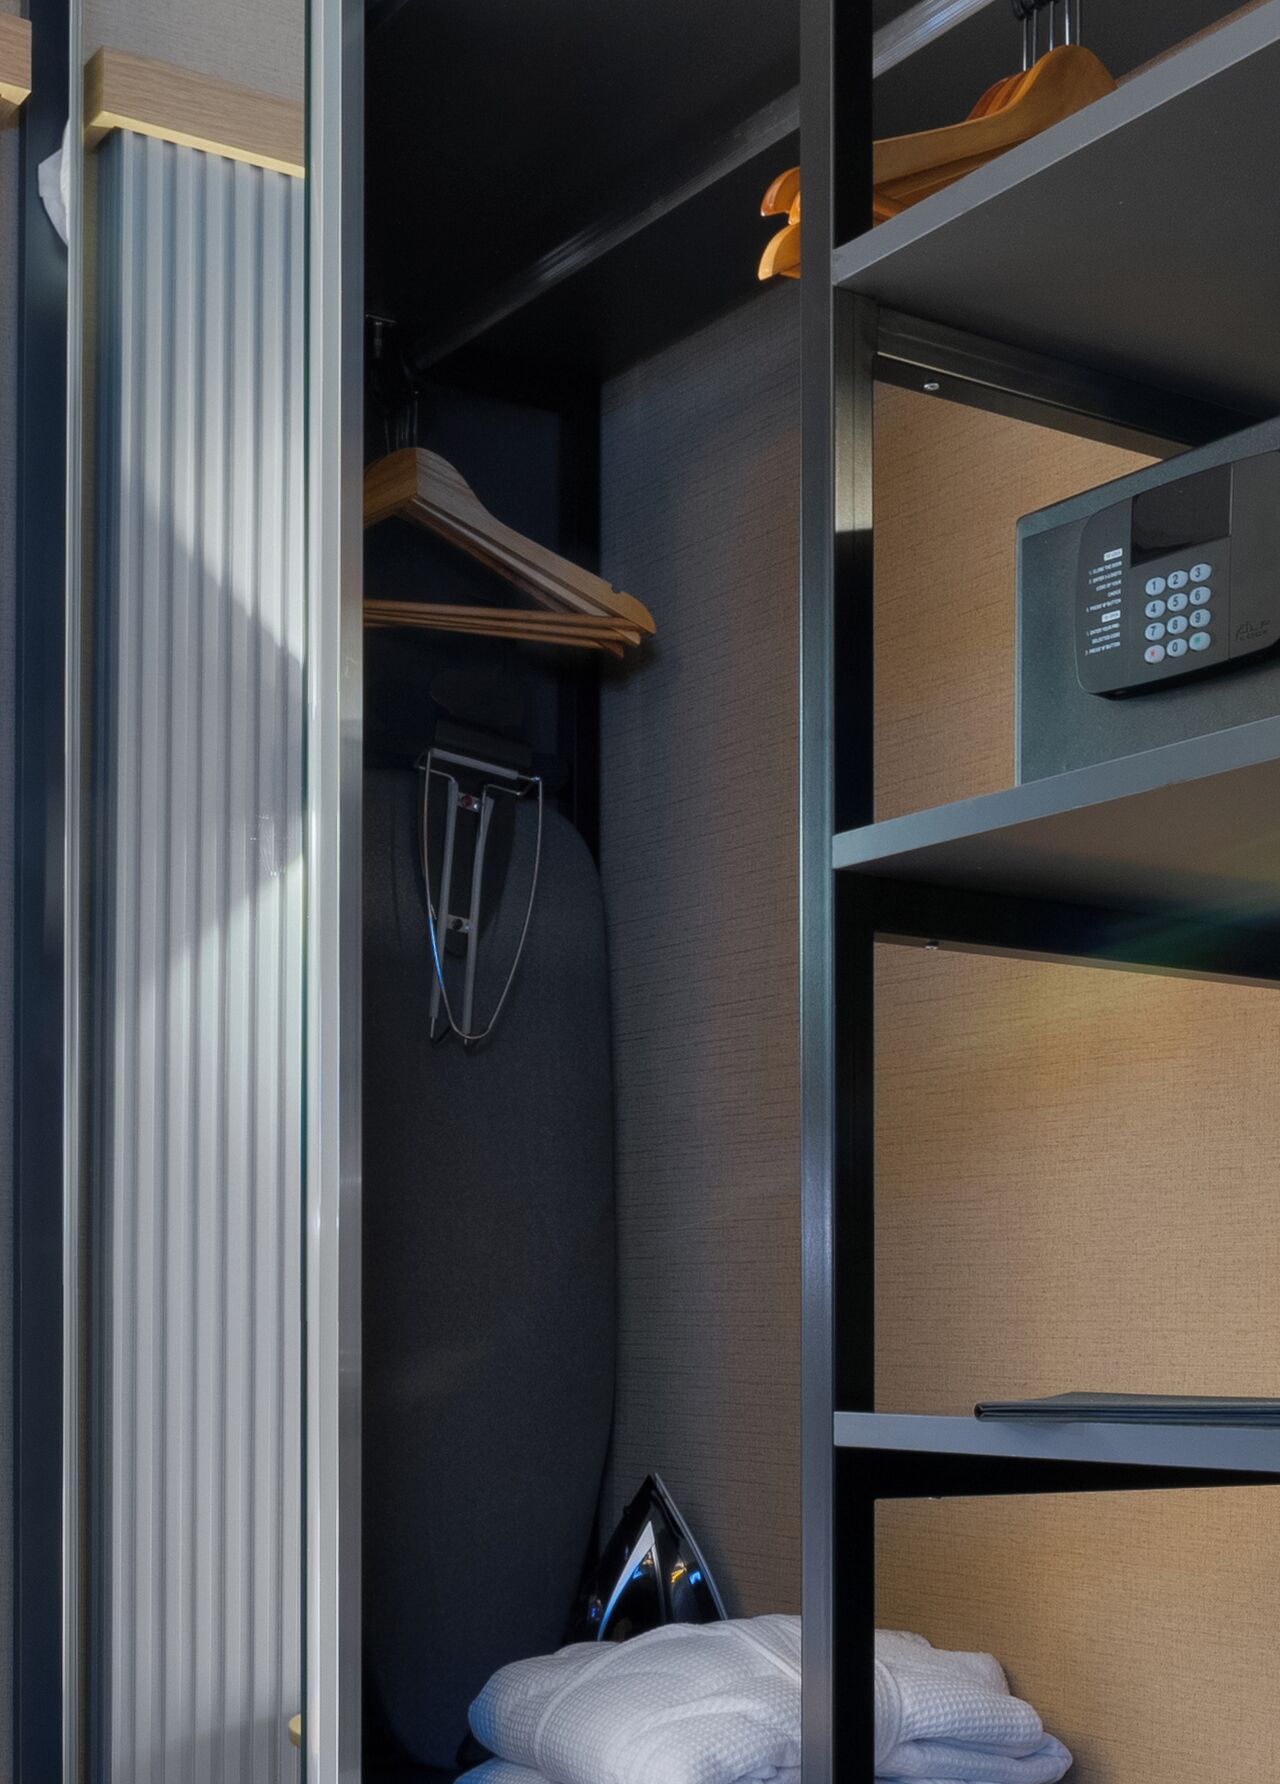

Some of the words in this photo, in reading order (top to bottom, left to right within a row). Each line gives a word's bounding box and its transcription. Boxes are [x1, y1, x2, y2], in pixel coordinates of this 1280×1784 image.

[1152, 581, 1156, 591] 1
[1172, 574, 1179, 585] 2
[1195, 567, 1201, 578] 3
[1150, 603, 1157, 613] 4
[1172, 597, 1179, 607] 5
[1195, 590, 1201, 601] 6
[1150, 625, 1156, 636] 7
[1172, 619, 1178, 630] 8
[1194, 612, 1201, 623] 9
[1172, 642, 1178, 653] 0
